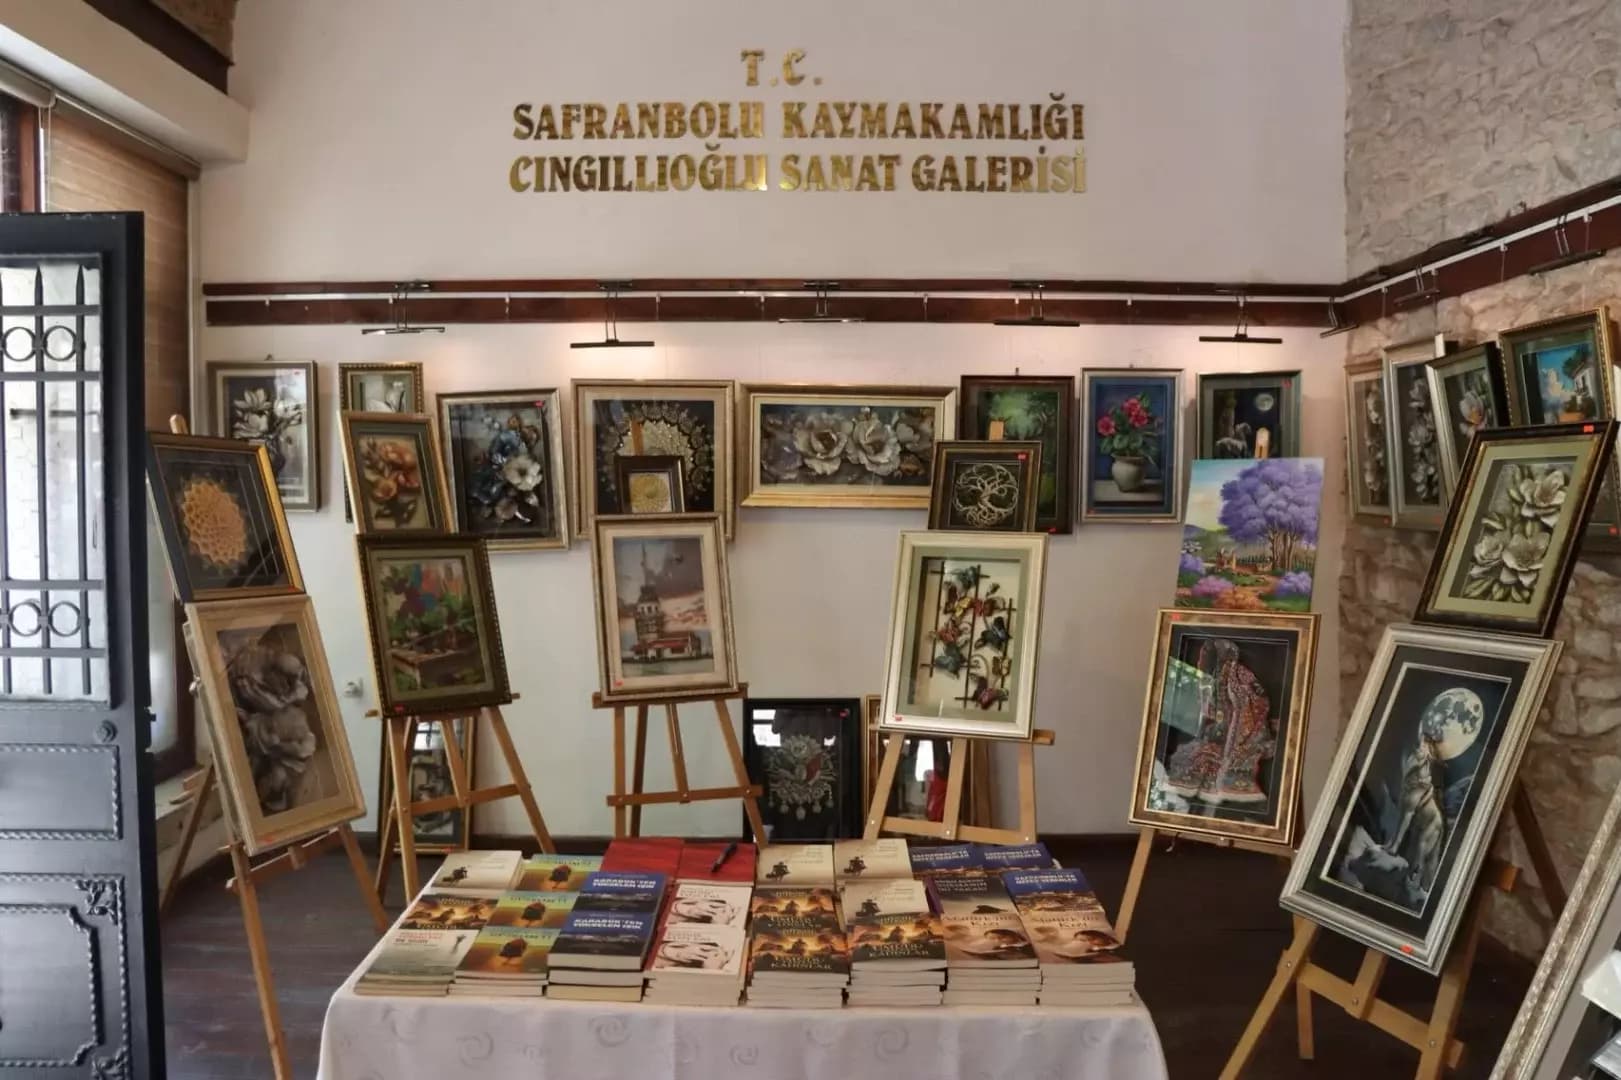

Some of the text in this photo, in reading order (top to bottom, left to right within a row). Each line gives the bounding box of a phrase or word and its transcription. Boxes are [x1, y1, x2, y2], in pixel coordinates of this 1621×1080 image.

[513, 92, 1084, 140] SAFRANBOLU KAYMAKAMLIĞI
[509, 142, 1086, 193] CINGILLIOĞLU SANAT GALERİSİ
